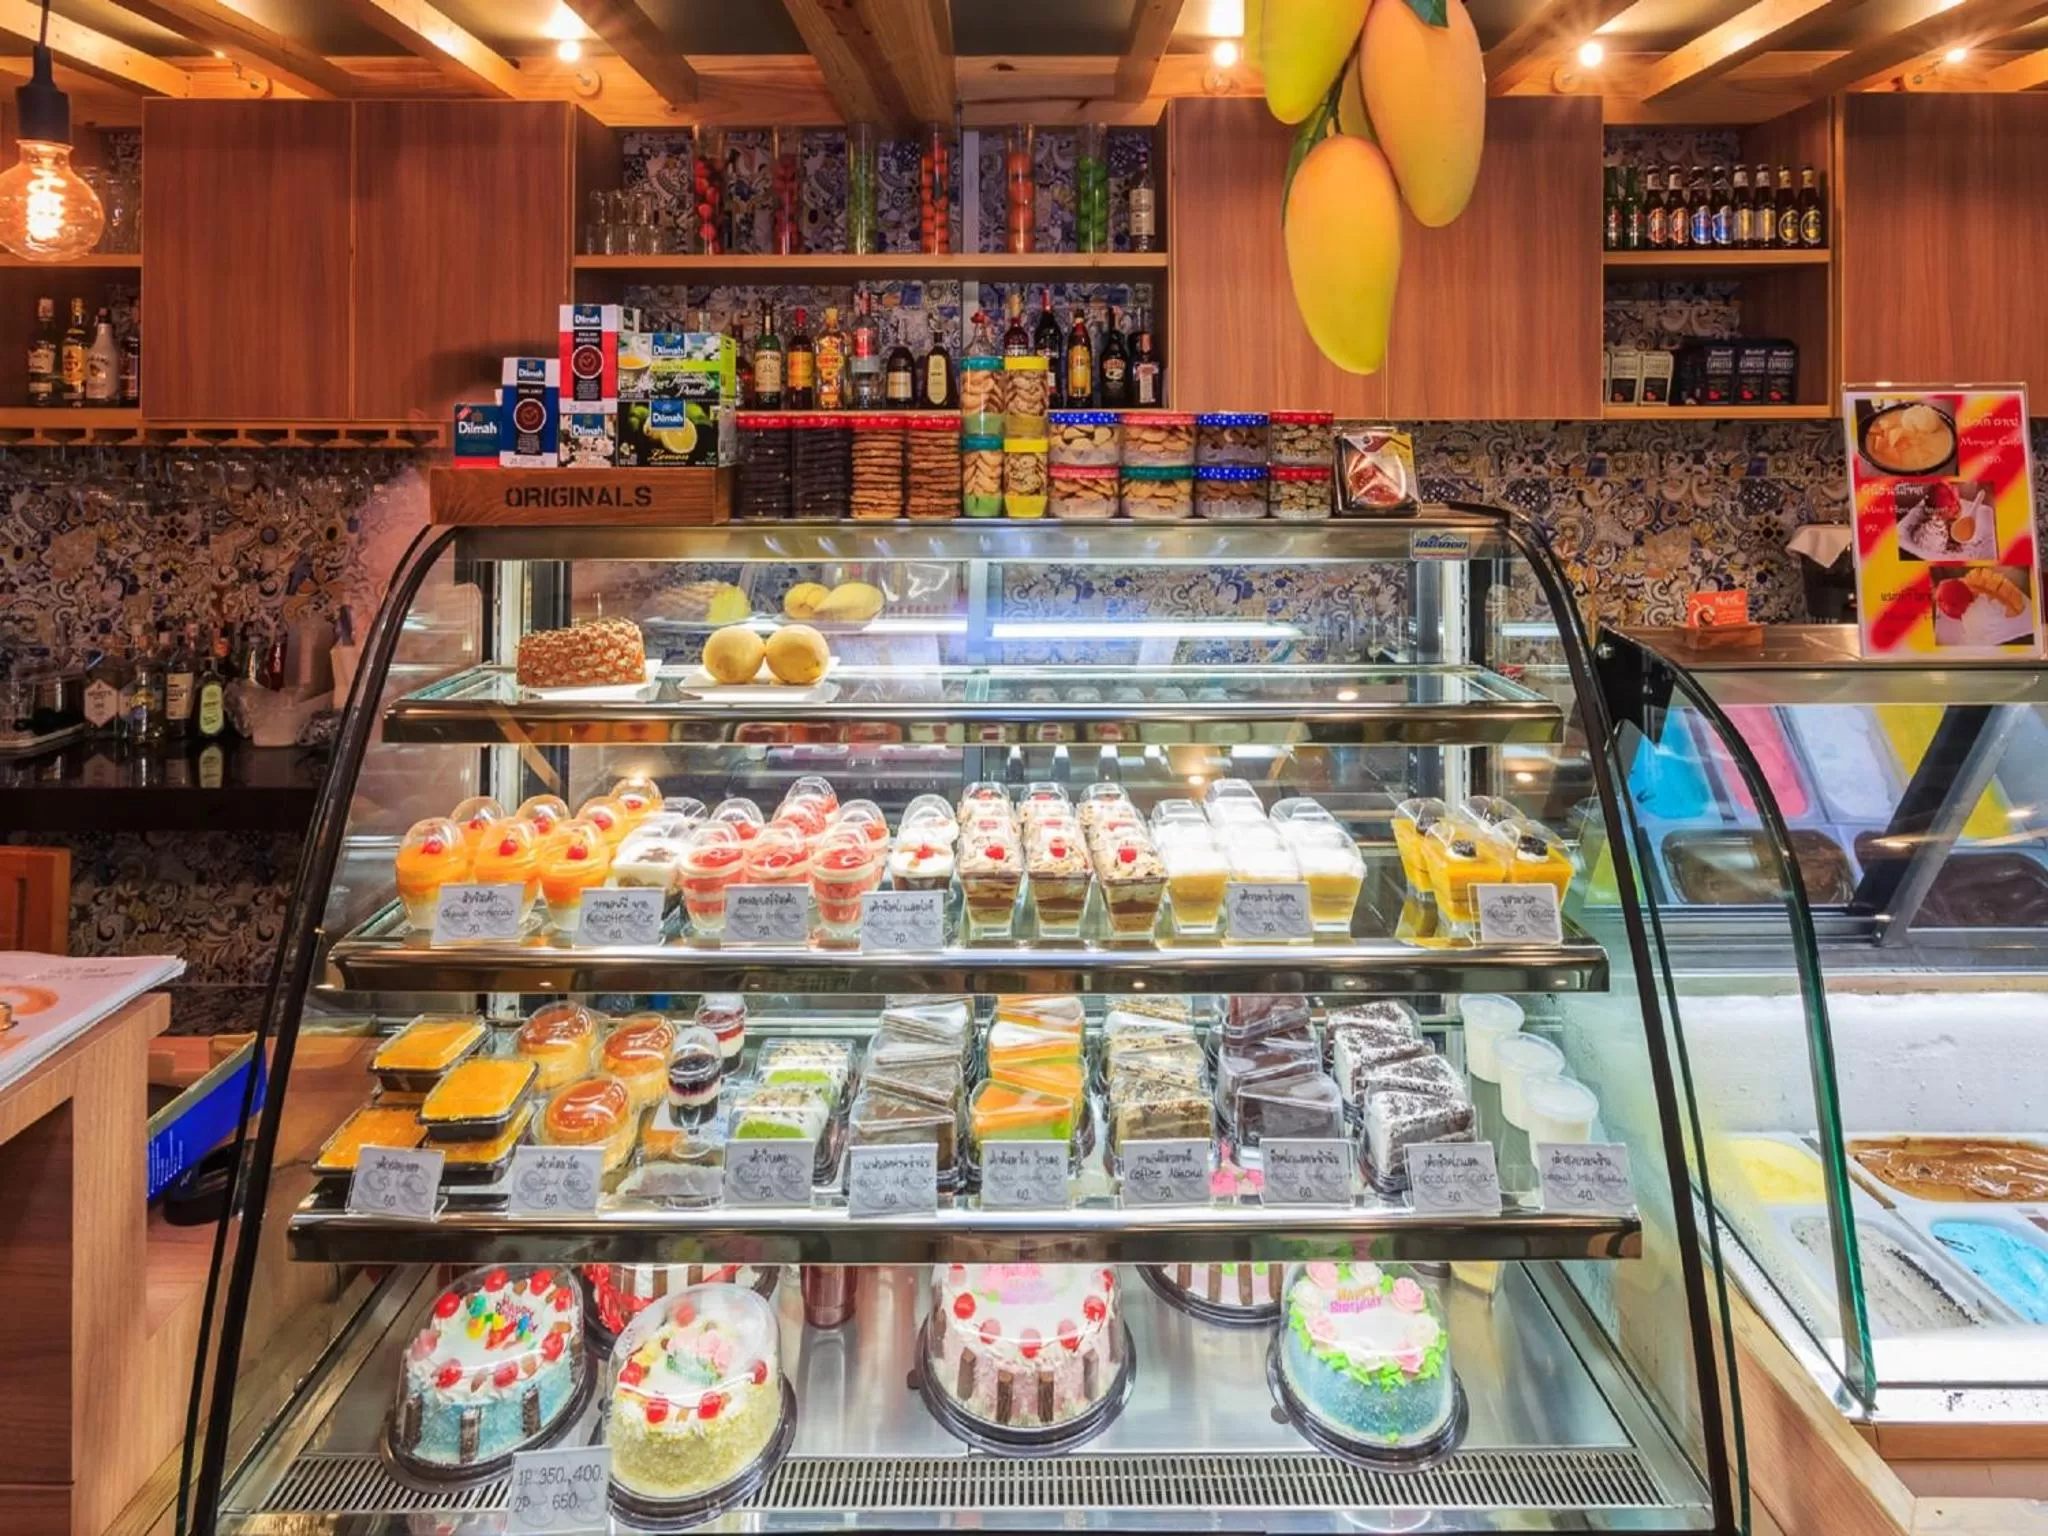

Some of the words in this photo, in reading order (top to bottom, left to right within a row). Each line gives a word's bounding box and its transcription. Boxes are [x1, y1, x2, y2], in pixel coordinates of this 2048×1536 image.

[574, 314, 601, 325] Dilmah
[653, 343, 684, 356] Dilmah
[518, 367, 544, 378] Dilmah
[652, 411, 684, 423] Dilmah
[458, 421, 498, 434] Dilmah
[572, 423, 604, 436] Dilmah
[504, 487, 653, 508] ORIGINALS
[513, 1495, 532, 1513] 2P
